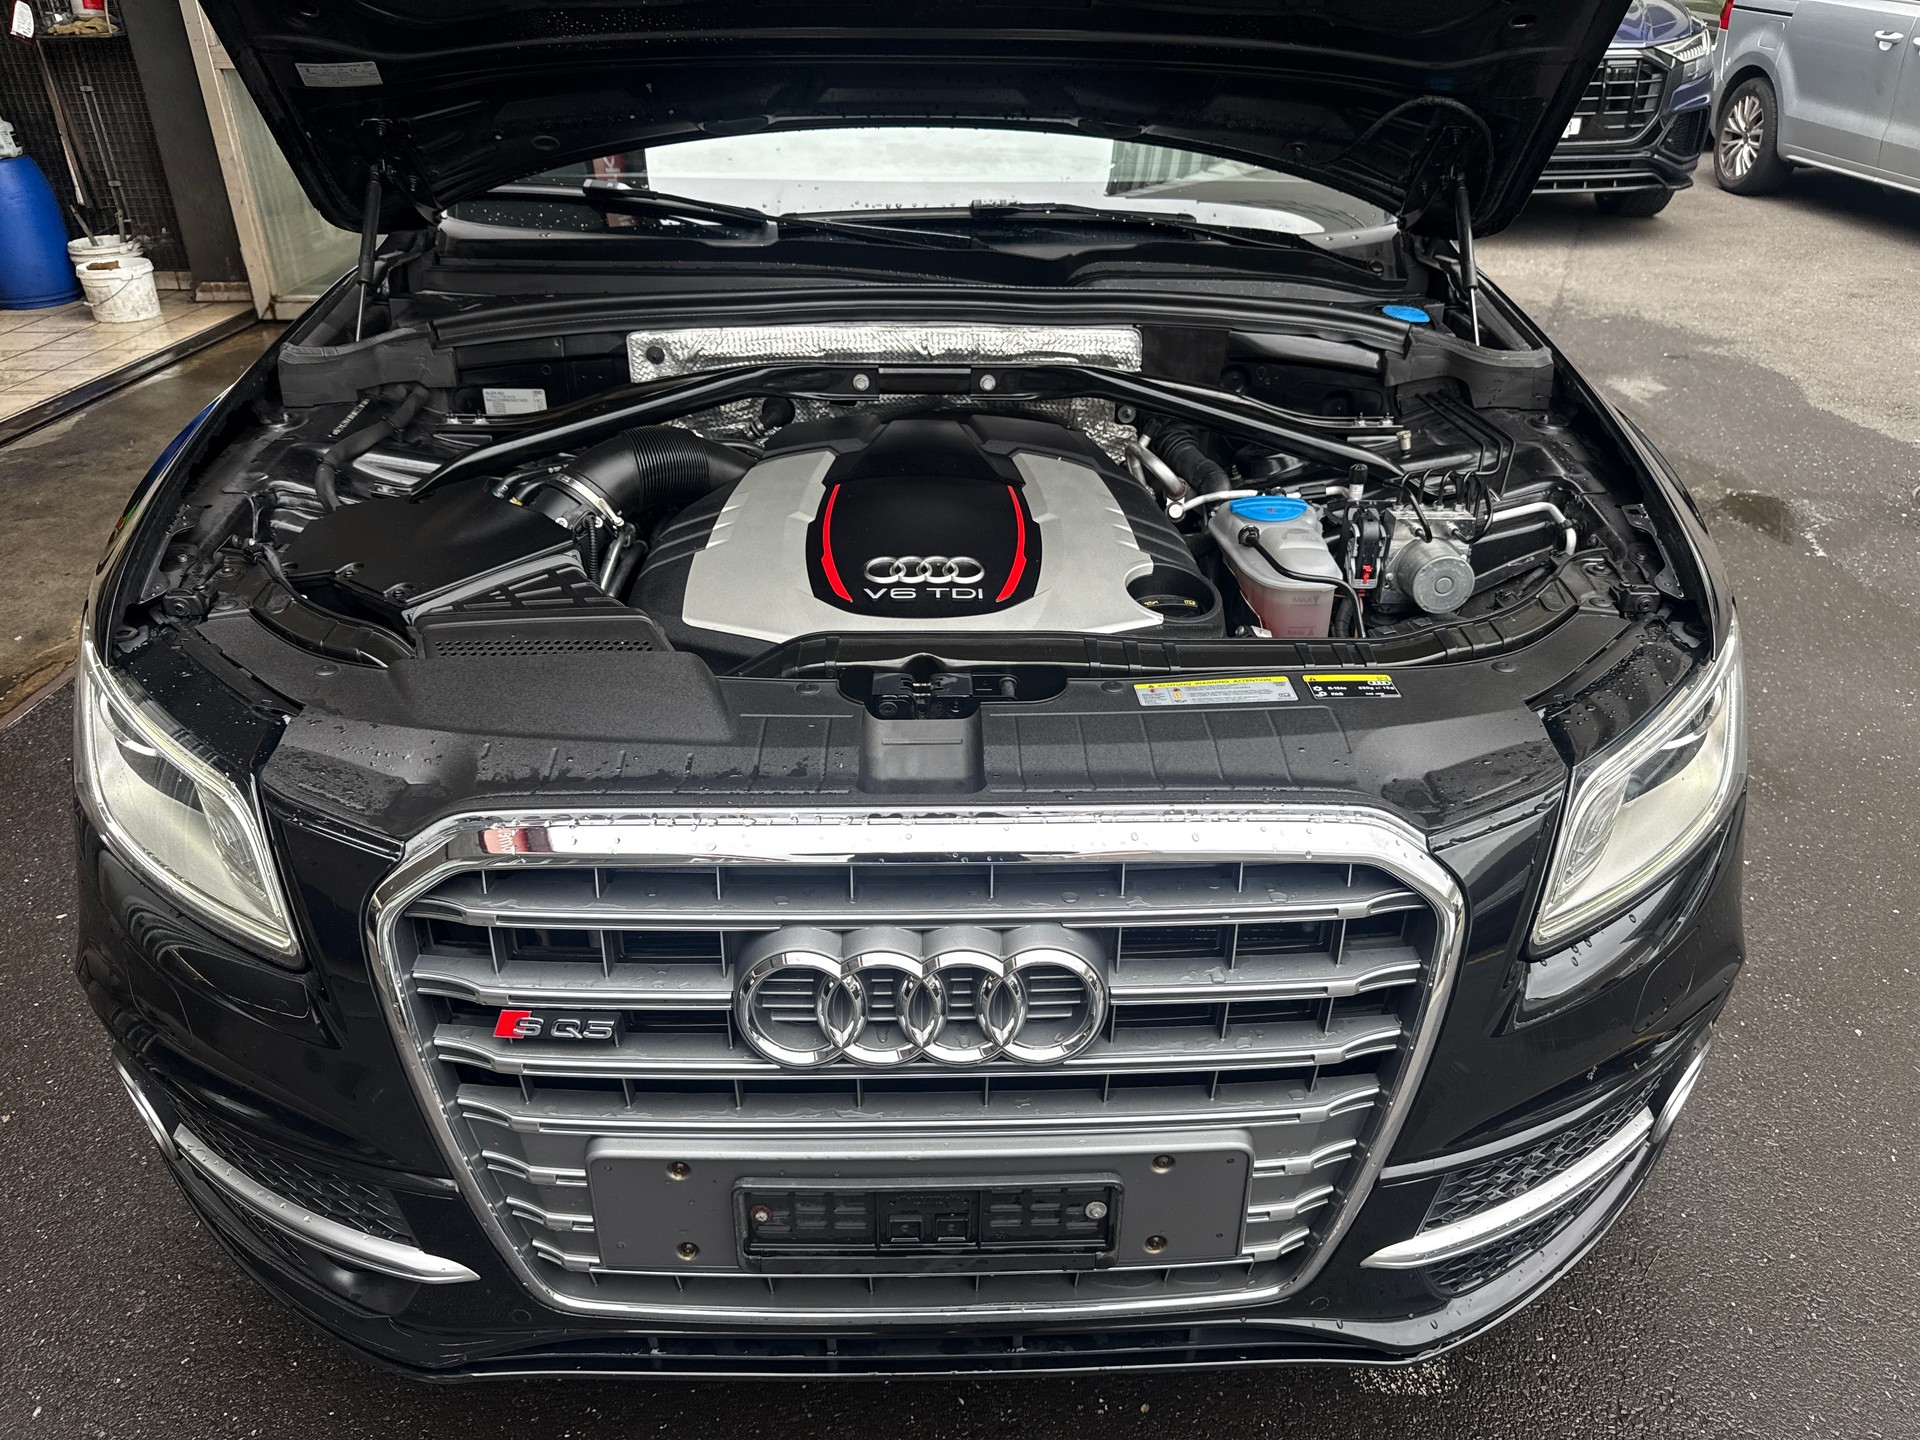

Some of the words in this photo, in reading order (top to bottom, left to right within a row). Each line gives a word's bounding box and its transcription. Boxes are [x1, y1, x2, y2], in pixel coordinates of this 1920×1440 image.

[863, 587, 917, 599] V6
[926, 587, 984, 599] TDI
[1293, 595, 1312, 603] MAX
